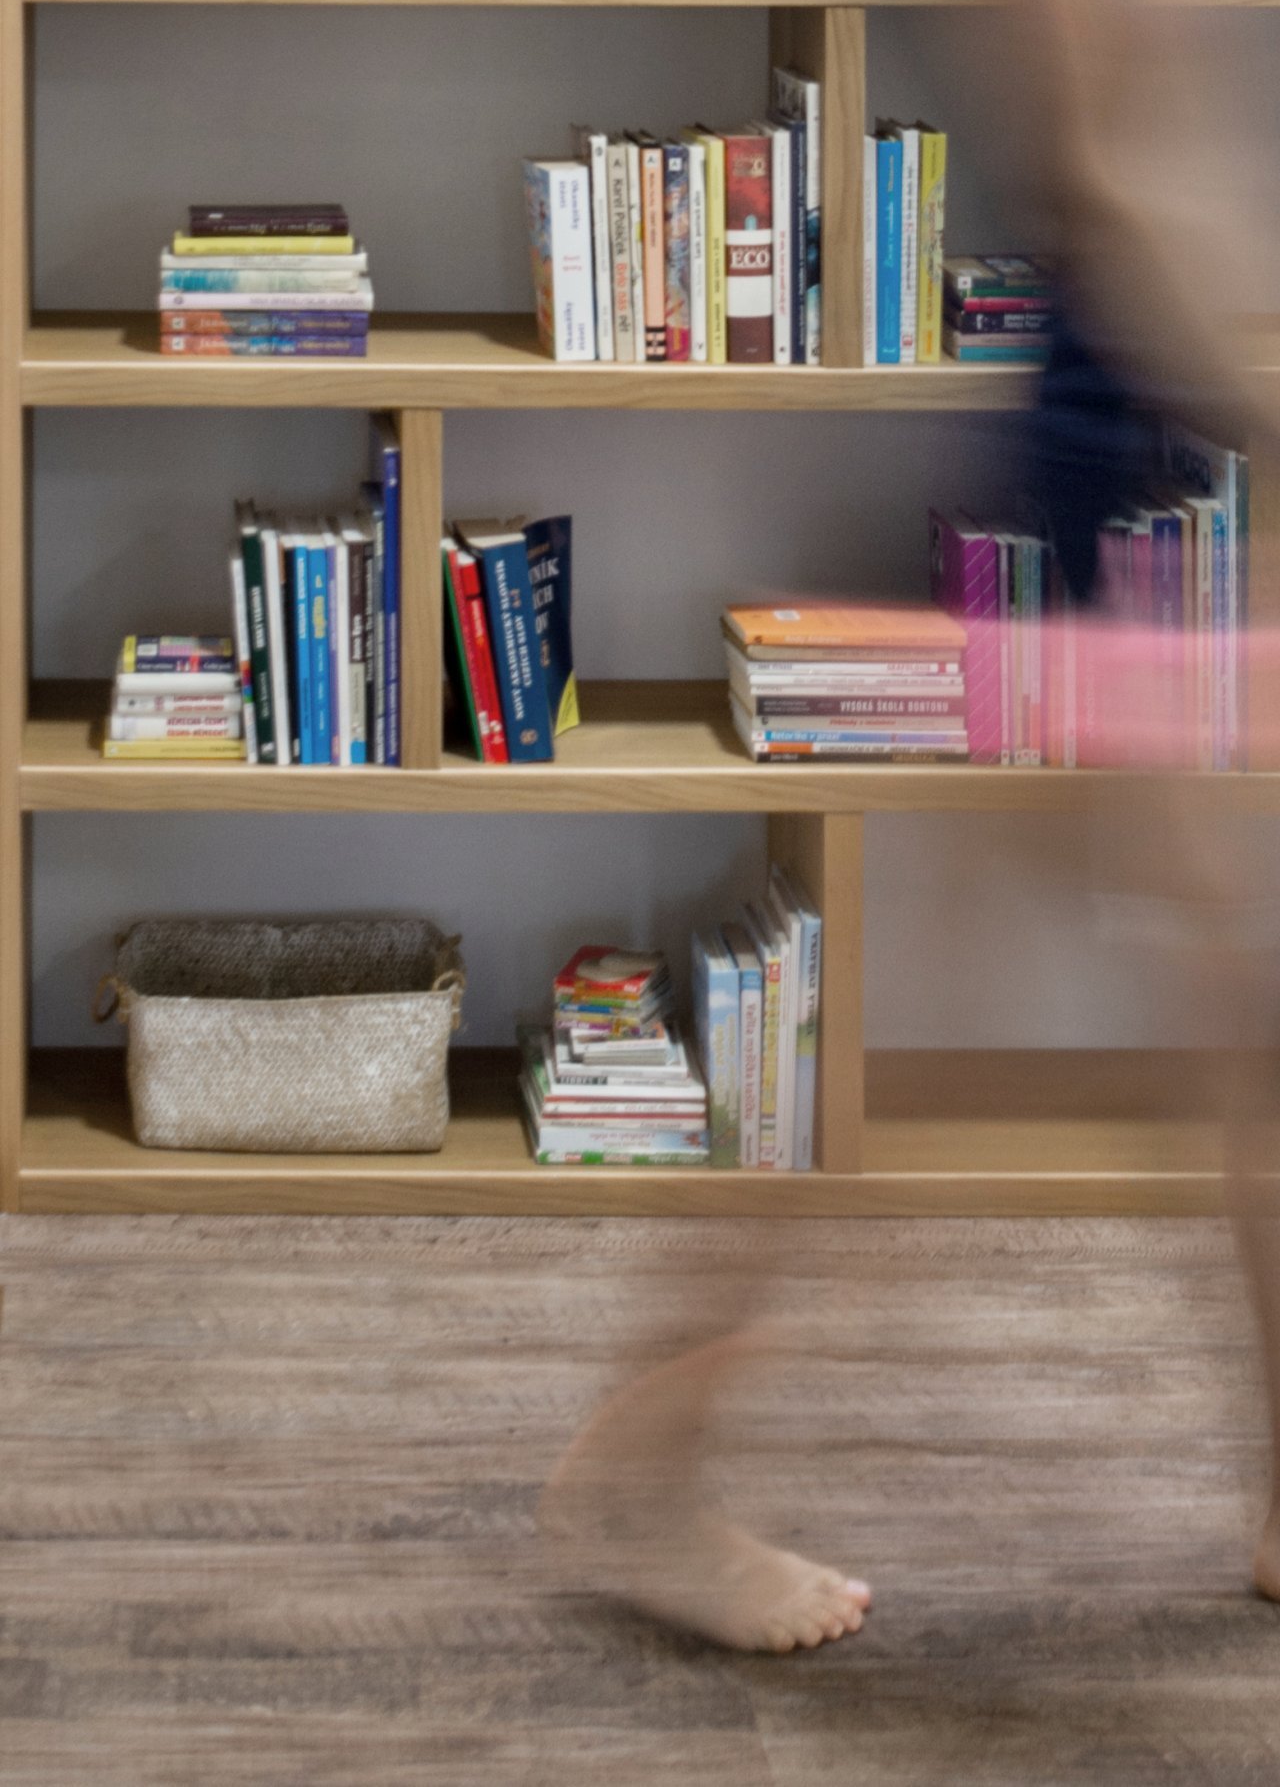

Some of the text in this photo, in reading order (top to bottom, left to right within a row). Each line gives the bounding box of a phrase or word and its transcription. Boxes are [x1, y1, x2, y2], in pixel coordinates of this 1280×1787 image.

[612, 178, 622, 208] Karel
[730, 248, 769, 268] ECO
[840, 700, 873, 712] VYSOKÁ
[877, 700, 904, 712] ŠKOLA
